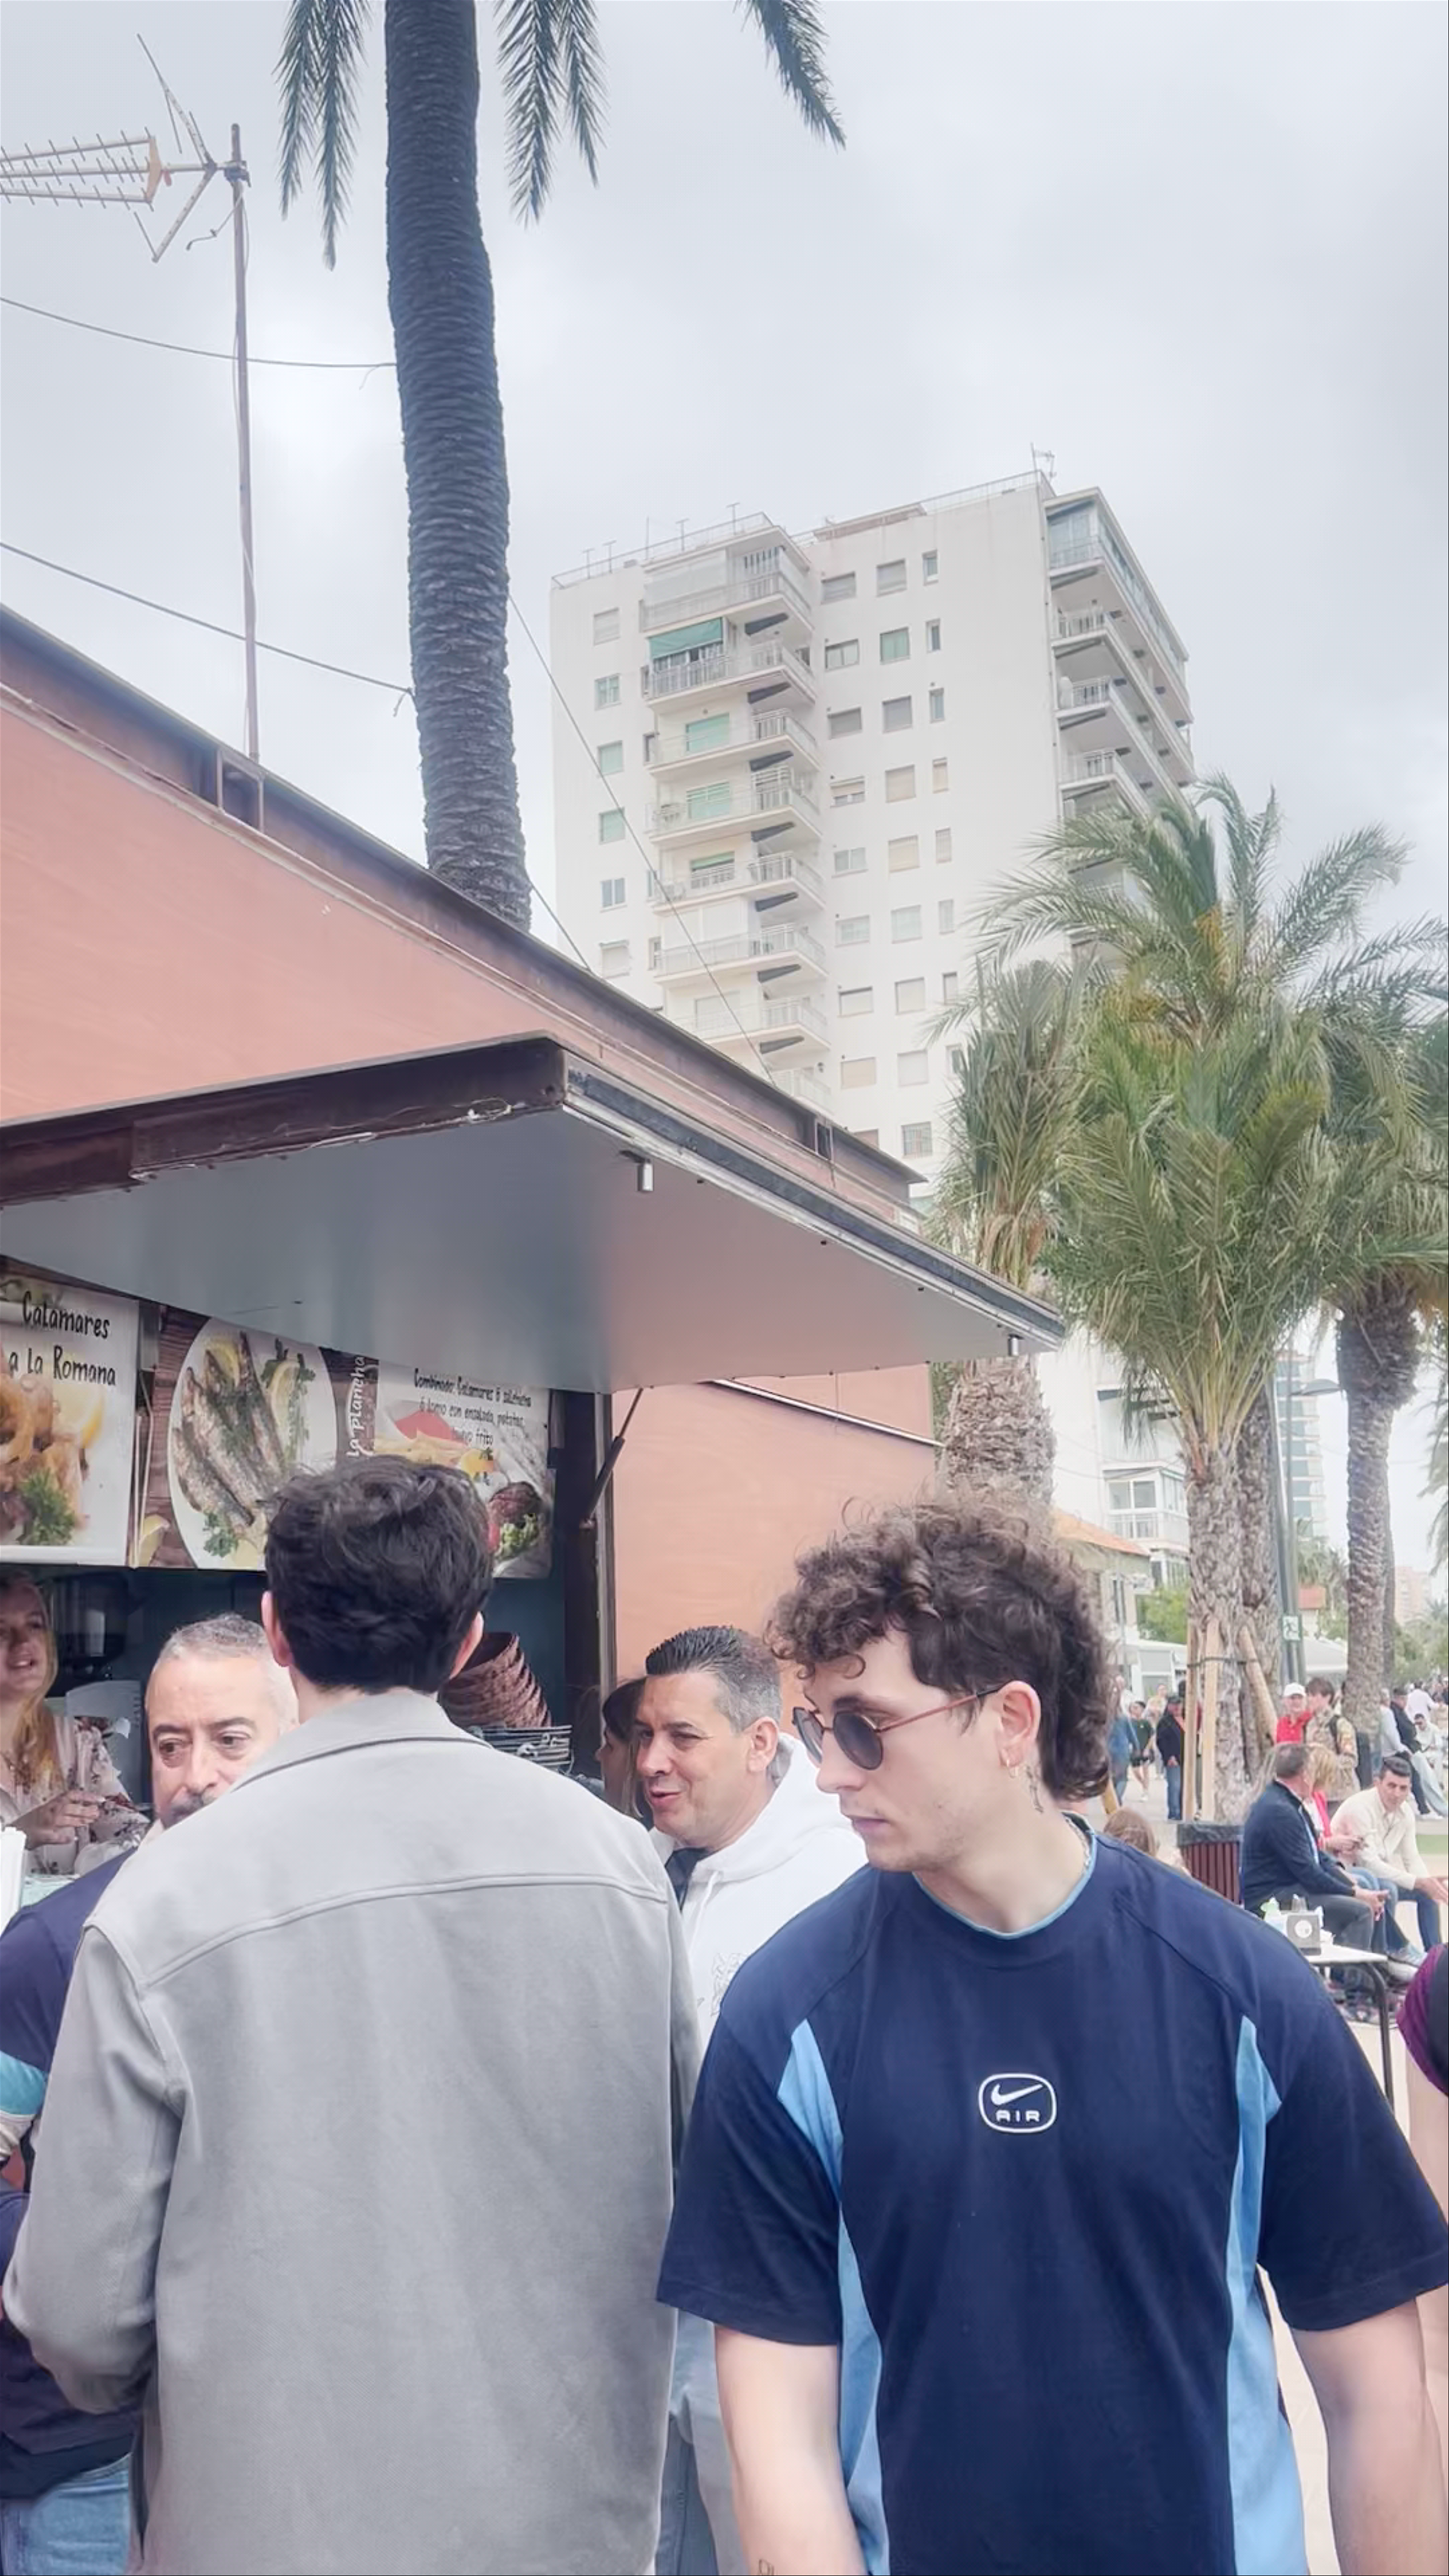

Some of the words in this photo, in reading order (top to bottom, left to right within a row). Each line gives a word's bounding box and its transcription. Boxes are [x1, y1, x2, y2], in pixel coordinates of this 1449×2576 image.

[23, 1290, 110, 1339] Calamares
[9, 1351, 18, 1375] a
[53, 1344, 116, 1386] Romana
[349, 1356, 365, 1430] plancha
[449, 1405, 461, 1417] con
[996, 2110, 1040, 2121] AIR
